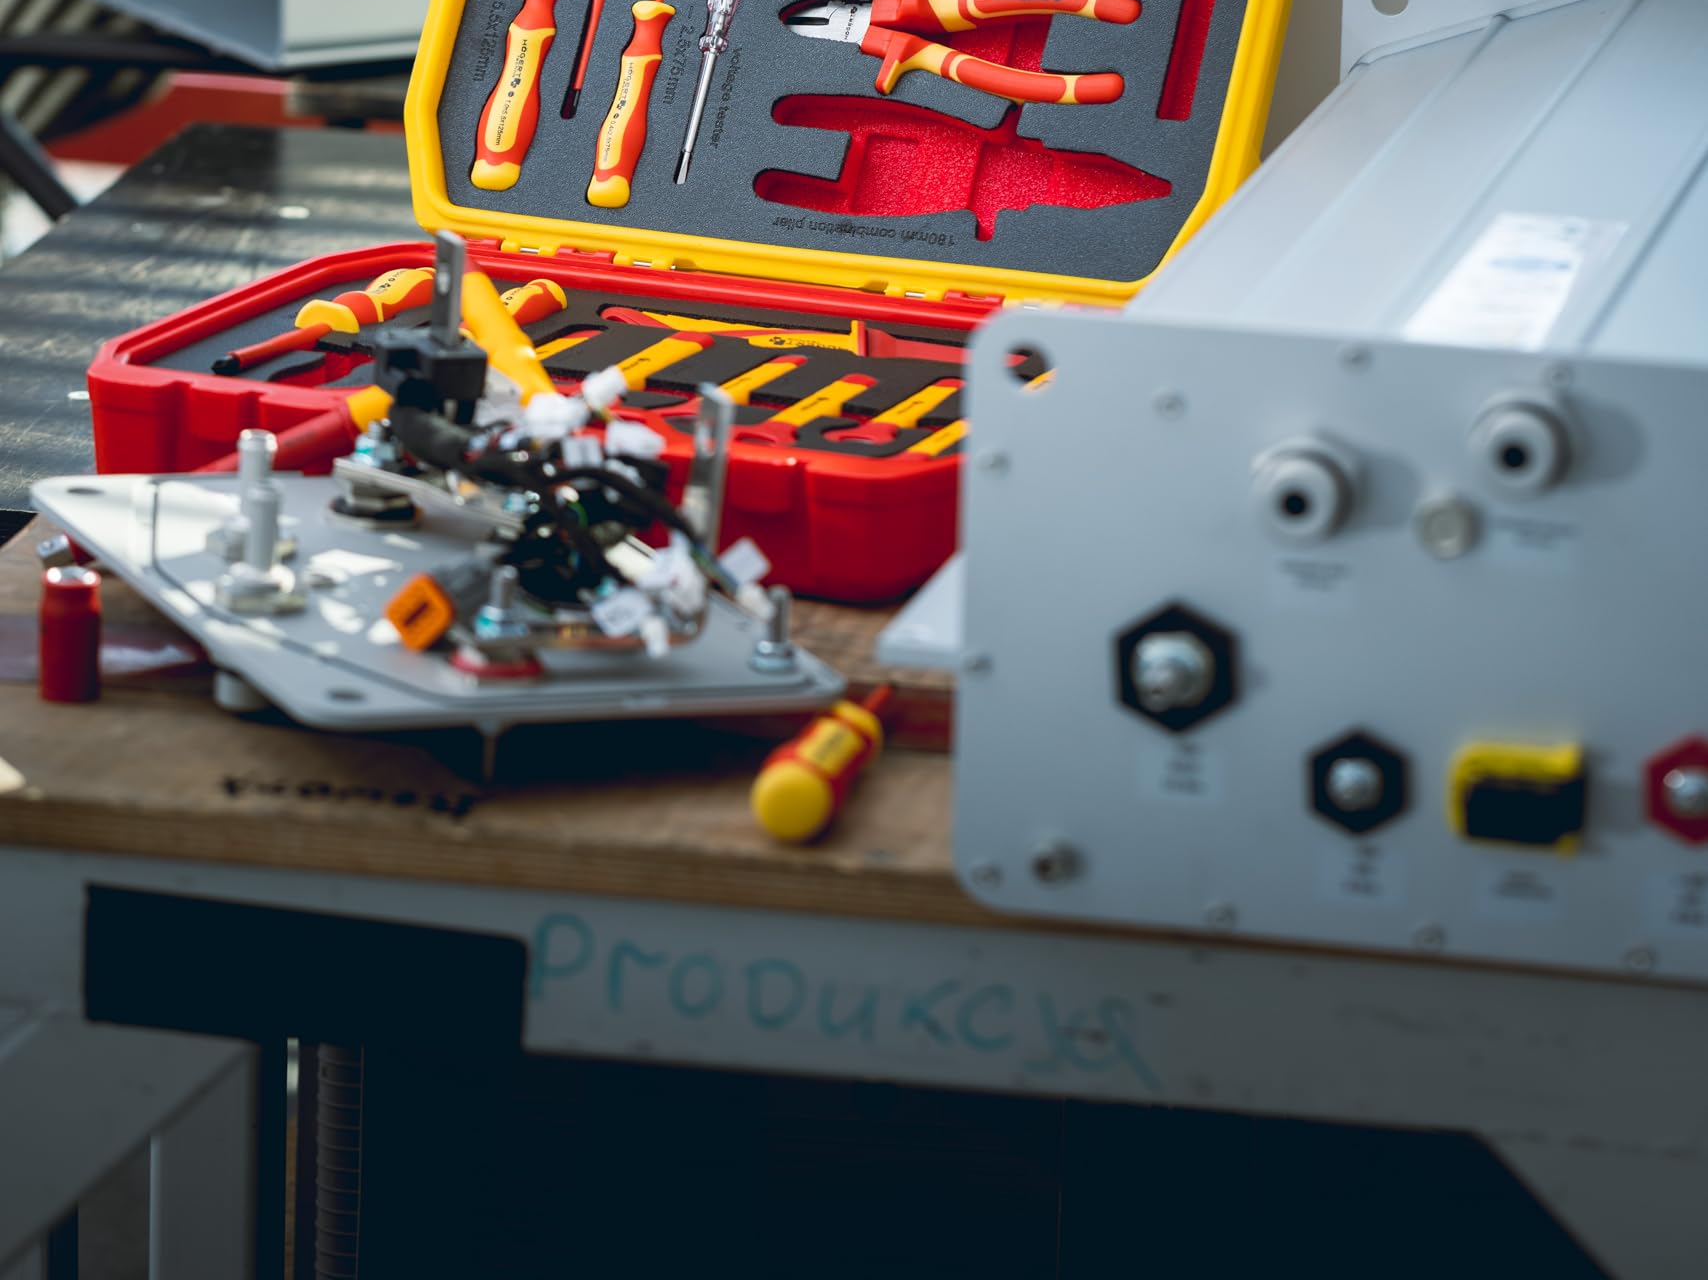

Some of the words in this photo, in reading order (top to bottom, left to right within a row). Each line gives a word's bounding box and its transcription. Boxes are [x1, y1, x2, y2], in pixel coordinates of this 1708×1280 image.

[710, 104, 730, 149] tester
[773, 216, 804, 231] plier
[809, 220, 896, 239] combination
